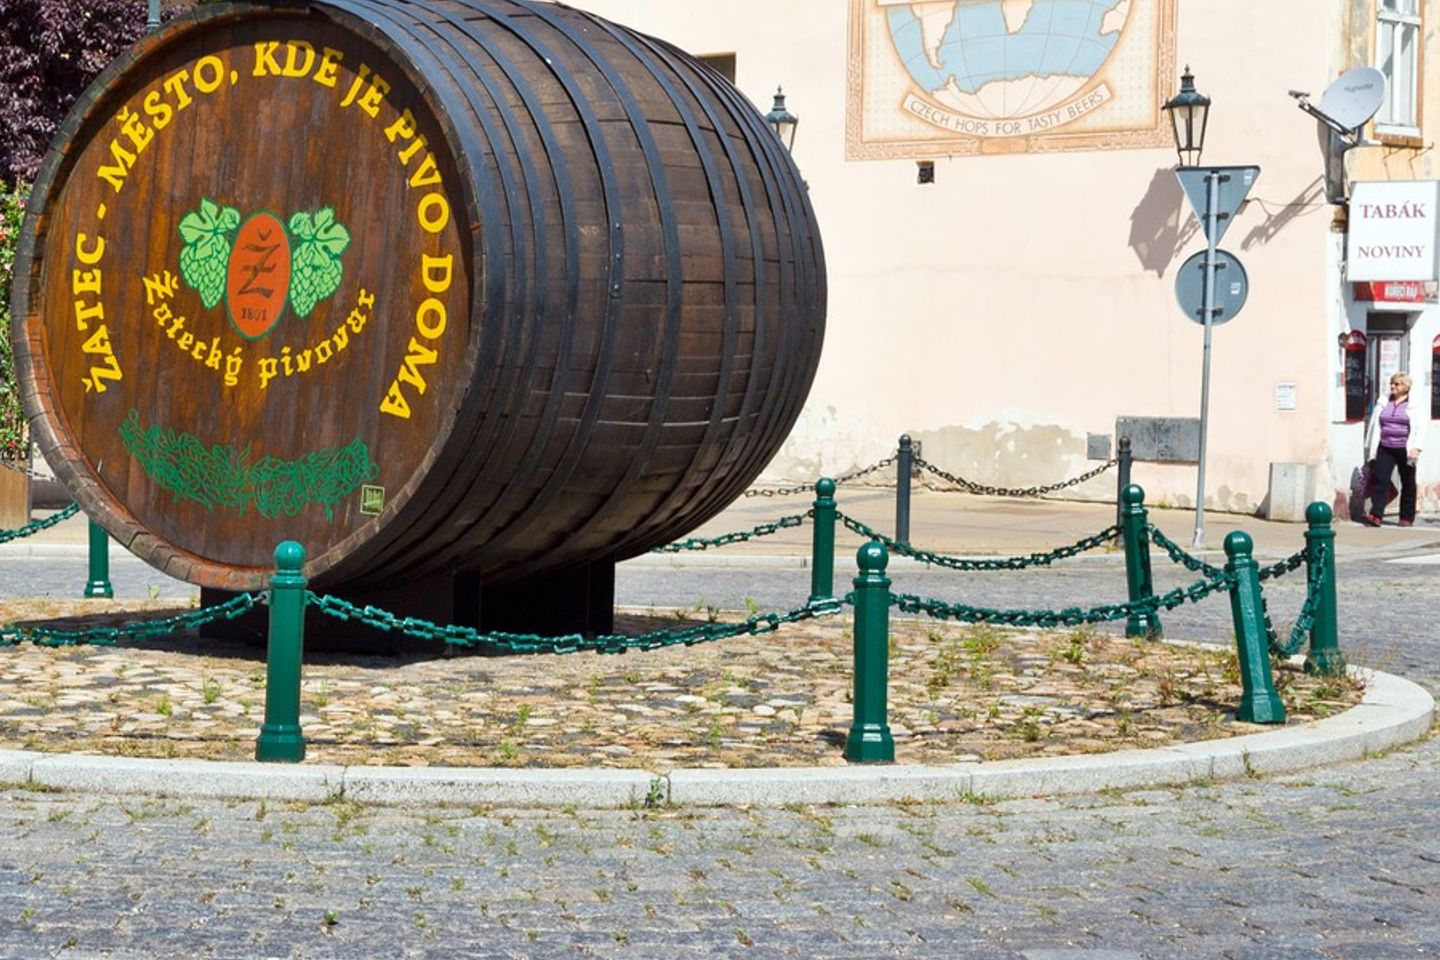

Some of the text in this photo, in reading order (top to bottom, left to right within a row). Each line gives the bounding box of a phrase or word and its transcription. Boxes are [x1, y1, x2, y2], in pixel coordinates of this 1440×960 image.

[252, 39, 344, 88] KDE
[340, 63, 391, 119] JE
[97, 54, 239, 194] MĚSTO,
[910, 92, 1105, 136] CZECH HOPS FOR TASTY BEERS
[384, 108, 450, 234] PIVO
[1358, 200, 1427, 219] TABÁK
[1358, 244, 1426, 259] NOVINY
[72, 232, 123, 394] ŽATEC
[142, 269, 376, 389] Žatecký pivovar
[379, 252, 453, 419] DOMA
